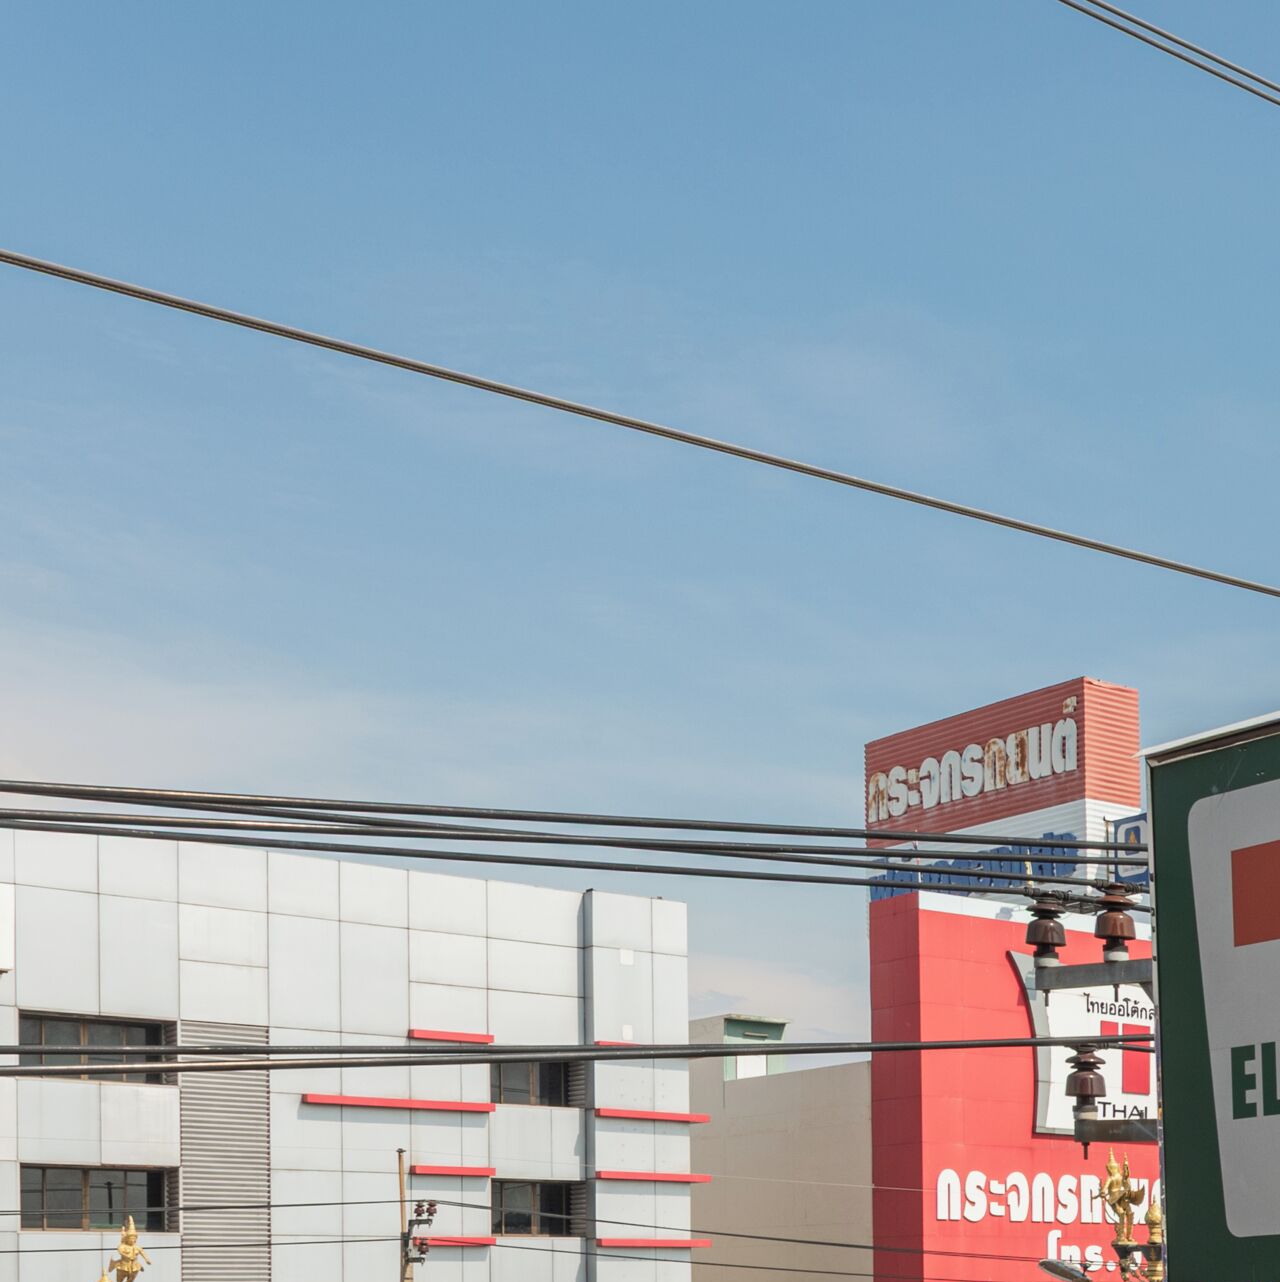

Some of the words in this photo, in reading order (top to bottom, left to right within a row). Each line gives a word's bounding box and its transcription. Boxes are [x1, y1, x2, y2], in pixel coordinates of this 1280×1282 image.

[868, 696, 1078, 823] กระจกรถยนต์
